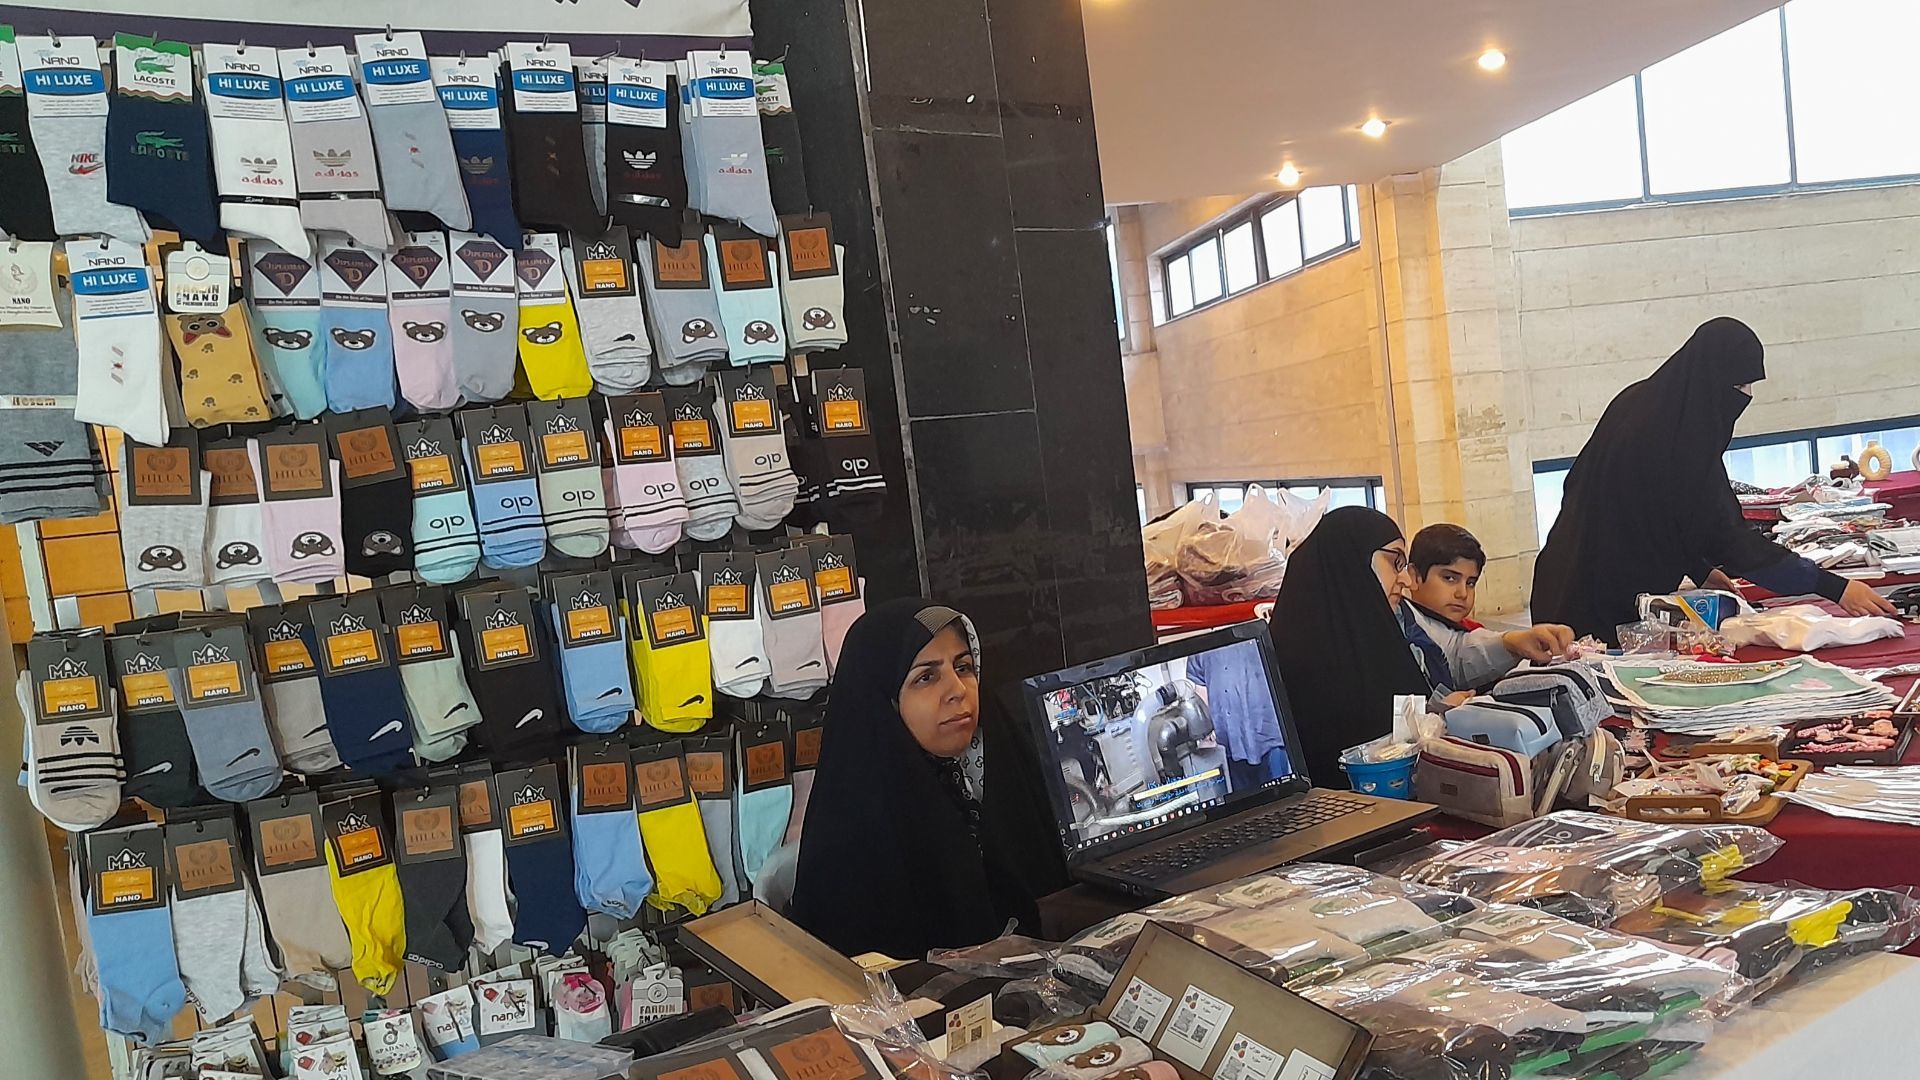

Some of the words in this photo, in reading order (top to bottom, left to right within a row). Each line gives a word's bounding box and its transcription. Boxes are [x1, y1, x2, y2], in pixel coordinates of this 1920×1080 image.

[376, 48, 409, 58] NANO
[41, 57, 80, 65] NANO
[225, 63, 260, 72] NANO
[526, 59, 557, 67] NANO
[299, 65, 333, 74] NANO
[372, 66, 386, 77] HI
[388, 64, 421, 75] LUXE
[711, 67, 738, 75] NANO
[36, 74, 51, 86] HI
[54, 74, 93, 86] LUXE
[133, 74, 176, 86] LACOSTE
[218, 79, 232, 88] HI
[235, 79, 270, 91] LUXE
[447, 75, 480, 83] NANO
[521, 74, 535, 84] HI
[536, 75, 566, 85] LUXE
[623, 74, 652, 84] NANO
[294, 83, 308, 93] HI
[311, 81, 344, 92] LUXE
[592, 87, 606, 97] LU
[706, 82, 718, 91] HI
[719, 82, 746, 91] LUXE
[442, 91, 455, 101] HI
[457, 91, 489, 101] LUXE
[616, 89, 629, 99] HI
[630, 90, 659, 102] LUXE
[756, 95, 779, 103] COSTE
[71, 153, 100, 163] NIKE
[315, 168, 359, 178] adidas
[241, 175, 285, 186] adidas
[586, 241, 617, 259] MAX
[88, 256, 126, 267] NANO
[83, 276, 97, 287] HI
[100, 273, 138, 286] LUXE
[735, 383, 765, 401] MAX
[828, 383, 854, 401] MAX
[624, 408, 654, 427] MAX
[674, 402, 703, 421] MAX
[546, 413, 578, 434] MAX
[481, 424, 515, 445] MAX
[407, 438, 442, 459] MAX
[817, 552, 845, 571] MAX
[713, 567, 742, 585] MAX
[772, 565, 801, 584] MAX
[571, 590, 602, 610] MAX
[656, 591, 686, 611] MAX
[401, 603, 434, 624] MAX
[485, 609, 519, 630] MAX
[268, 620, 303, 641] MAX
[330, 613, 367, 635] MAX
[192, 643, 230, 665] MAX
[49, 656, 89, 679] MAX
[125, 652, 163, 674] MAX
[513, 784, 545, 805] MAX
[337, 813, 371, 834] MAX
[108, 848, 146, 871] MAX
